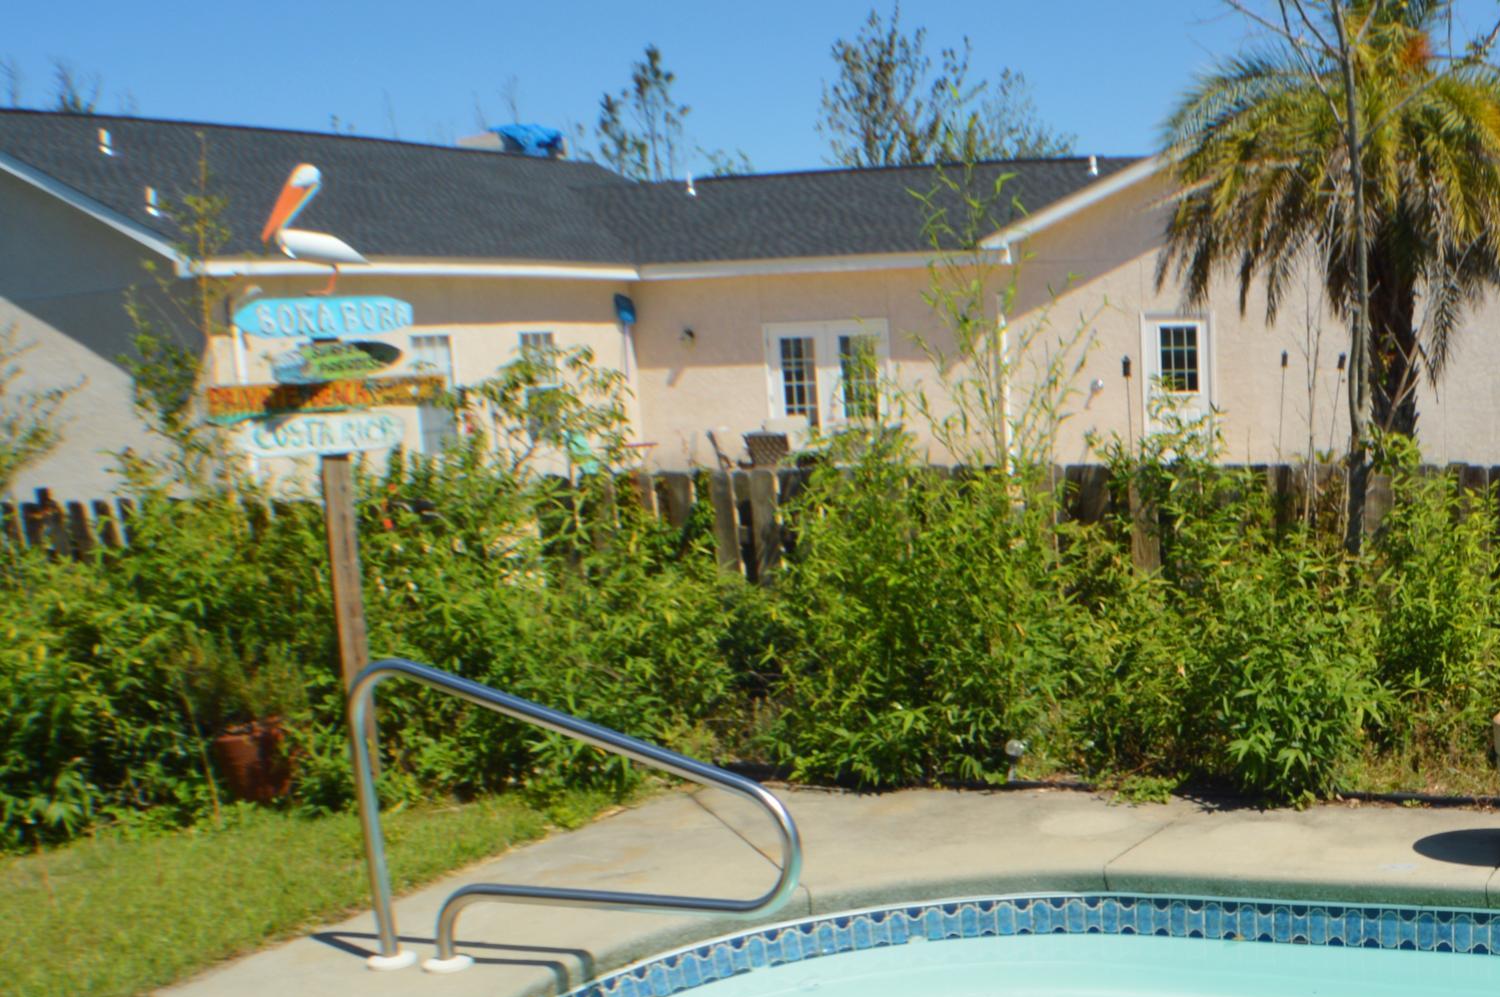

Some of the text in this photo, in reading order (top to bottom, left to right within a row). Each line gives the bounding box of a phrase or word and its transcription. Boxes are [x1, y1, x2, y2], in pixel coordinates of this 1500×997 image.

[255, 301, 410, 335] BORA BORA
[253, 415, 394, 450] COSTA RICA
